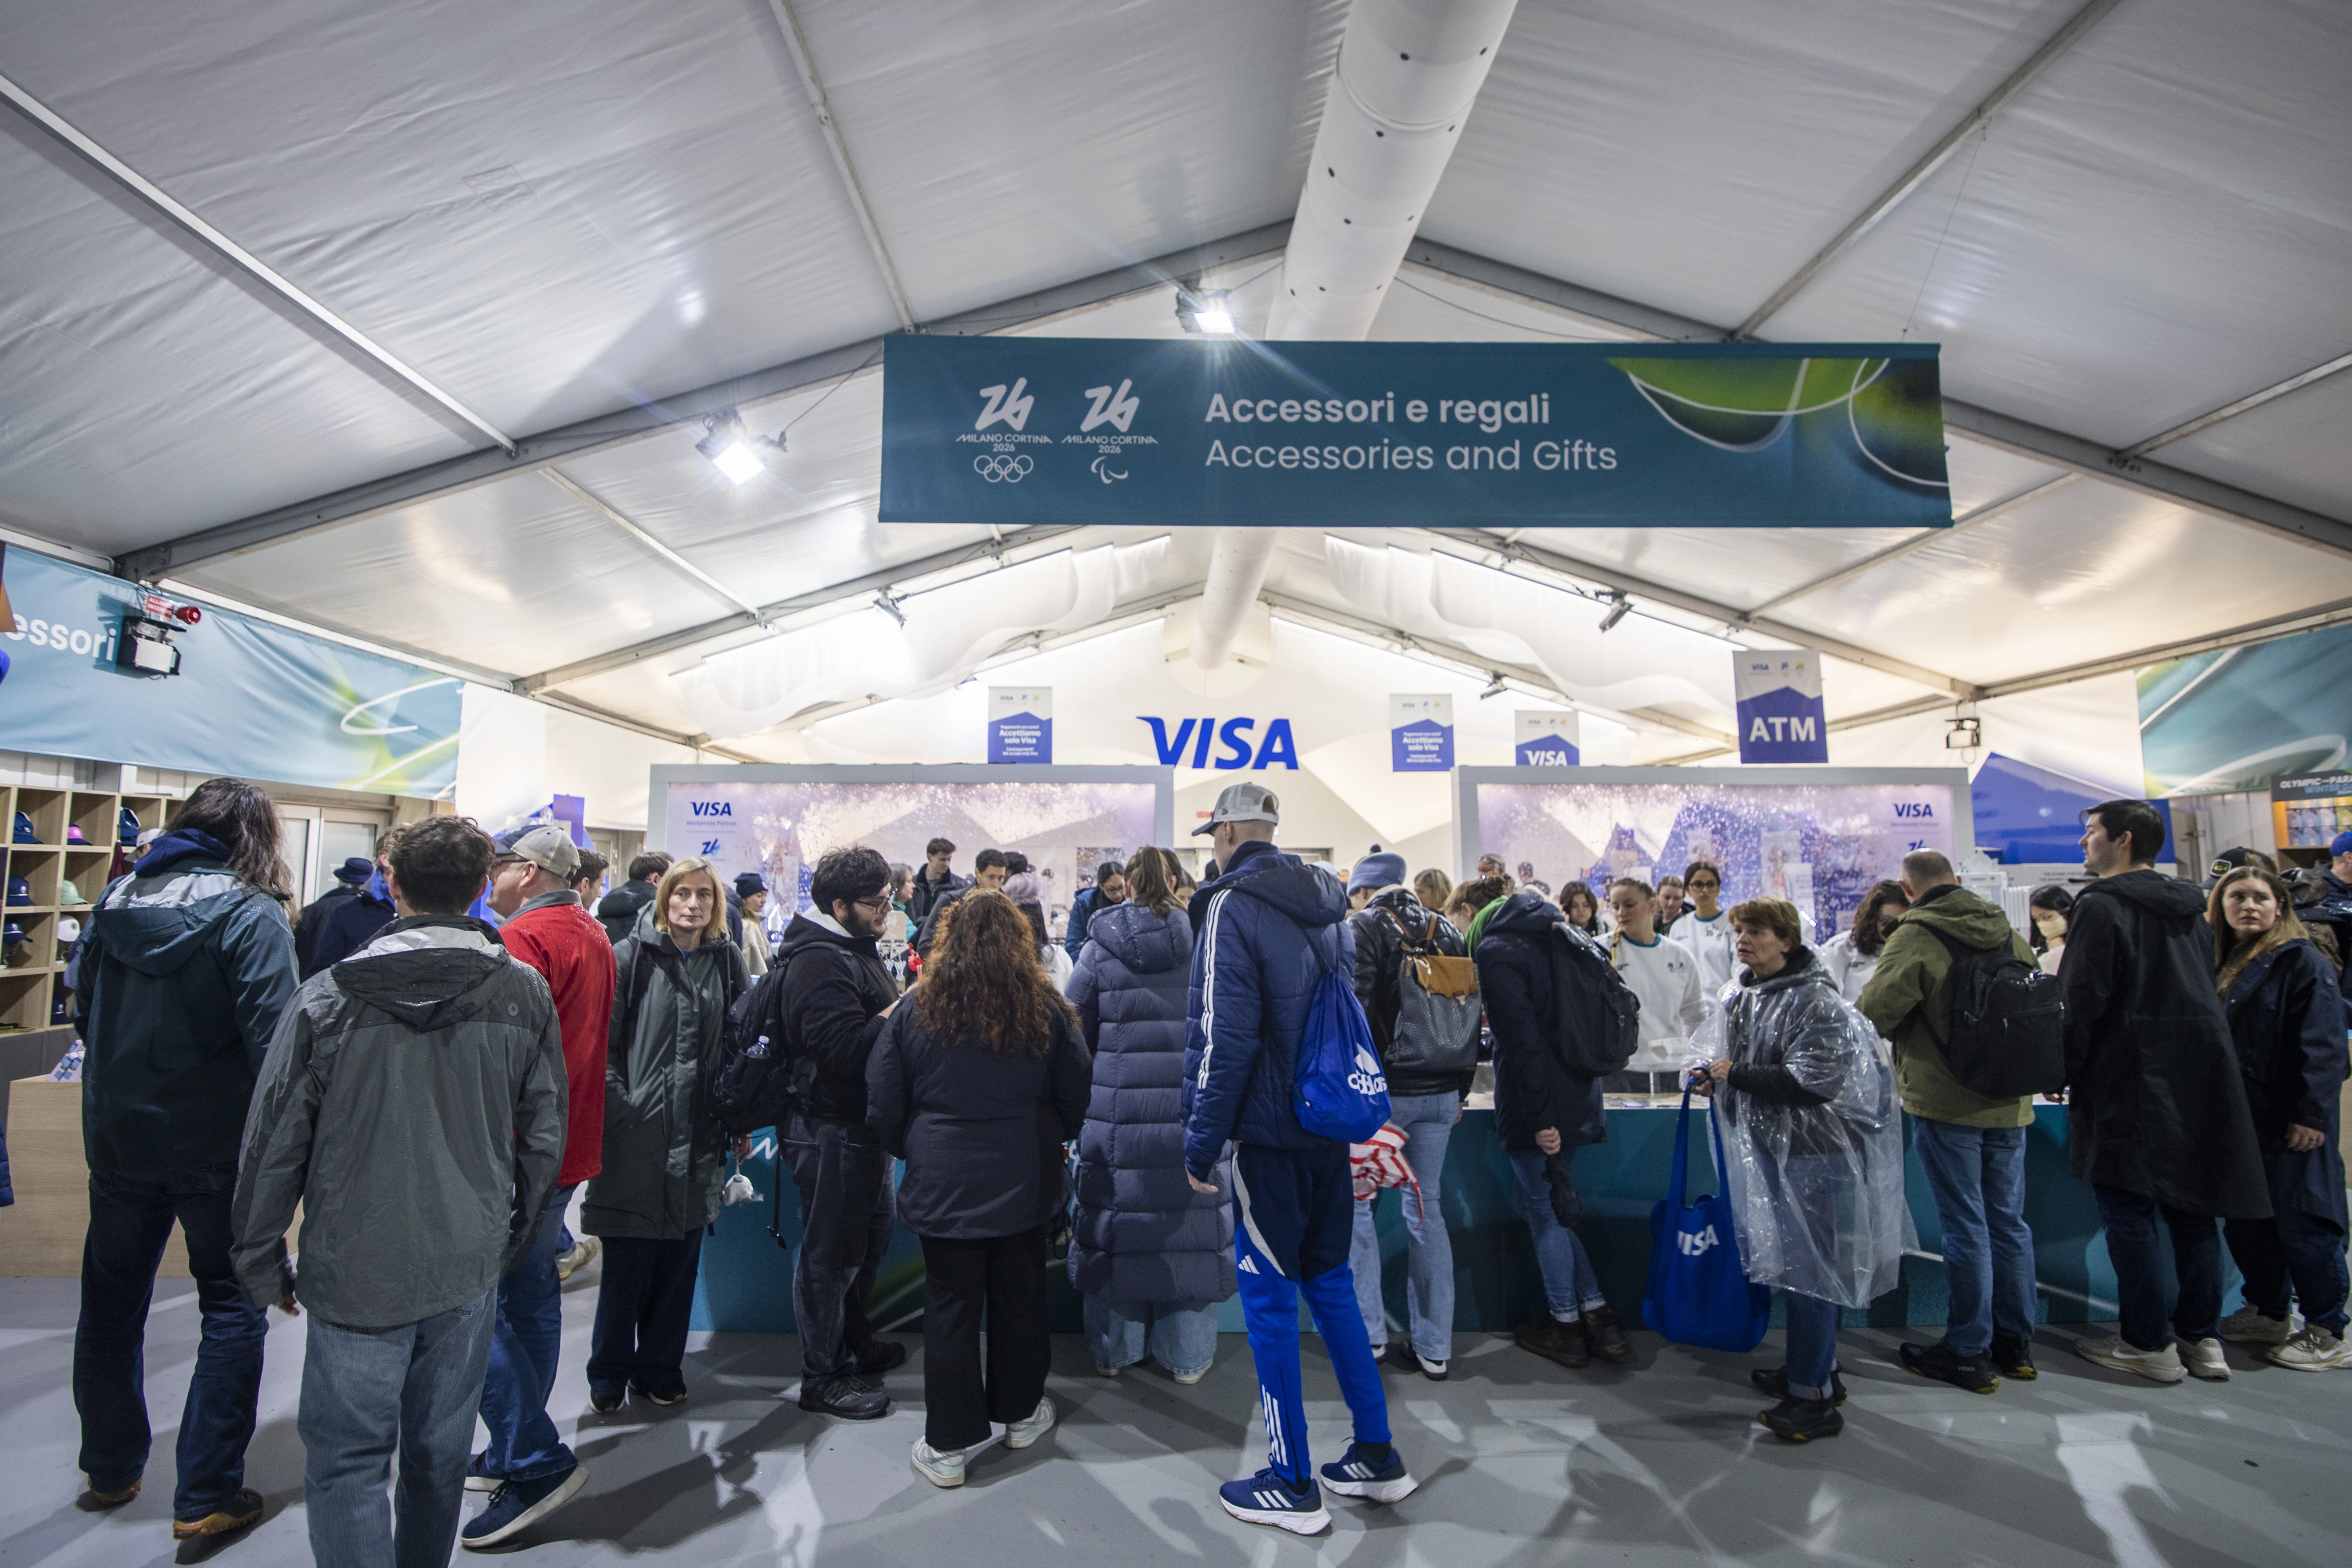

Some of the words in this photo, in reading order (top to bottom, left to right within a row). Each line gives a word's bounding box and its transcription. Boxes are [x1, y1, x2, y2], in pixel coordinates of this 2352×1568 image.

[1205, 391, 1394, 423] Accessori
[1406, 400, 1428, 423] e
[1440, 393, 1549, 433] regali
[955, 434, 1003, 442] MILANO
[1004, 434, 1053, 443] CORTINA
[1061, 435, 1108, 444] MILANO
[1110, 436, 1159, 444] CORTINA
[993, 443, 1015, 452] 2026
[1098, 445, 1121, 453] 2026
[1205, 438, 1434, 470] Accessories
[1446, 439, 1520, 470] and
[1533, 439, 1618, 470] Gifts
[1749, 716, 1816, 742] ATM
[1136, 716, 1299, 770] VISA
[1524, 750, 1568, 767] VISA
[690, 801, 731, 816] VISA
[1893, 803, 1933, 817] VISA
[1348, 1074, 1388, 1095] addas
